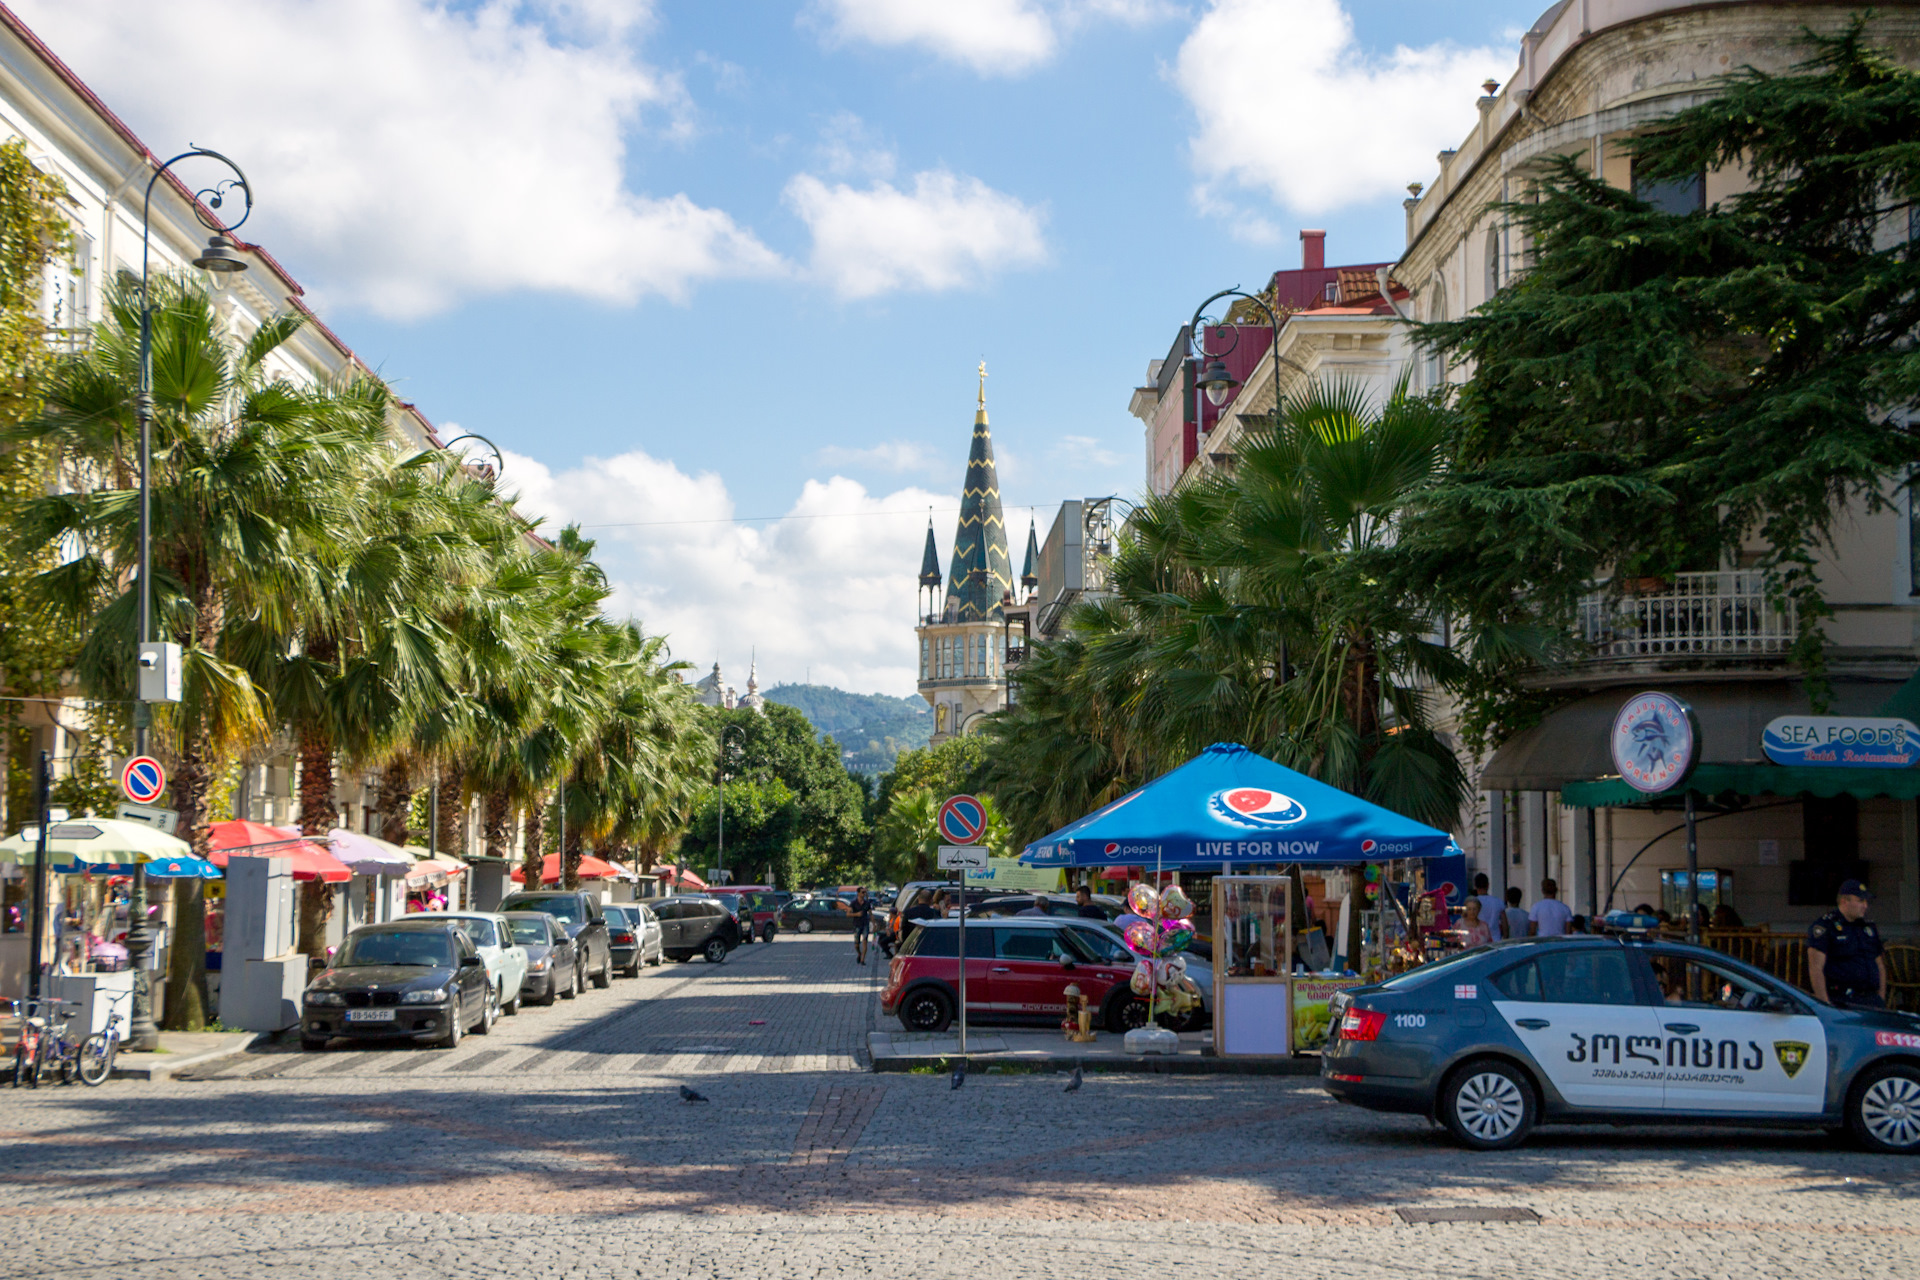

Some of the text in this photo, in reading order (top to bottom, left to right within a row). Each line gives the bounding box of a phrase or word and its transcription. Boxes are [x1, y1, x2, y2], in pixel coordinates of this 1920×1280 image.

[1781, 725, 1906, 746] SEA FOODS
[1625, 753, 1682, 782] ORKINOS
[1122, 844, 1157, 857] pepsi
[1196, 841, 1320, 856] LIVE FOR NOW
[1379, 842, 1412, 854] pepsi
[1022, 1003, 1041, 1011] JCW
[1394, 1014, 1426, 1028] 1100
[1893, 1033, 1920, 1048] 112
[1566, 1032, 1764, 1071] პოლიცია
